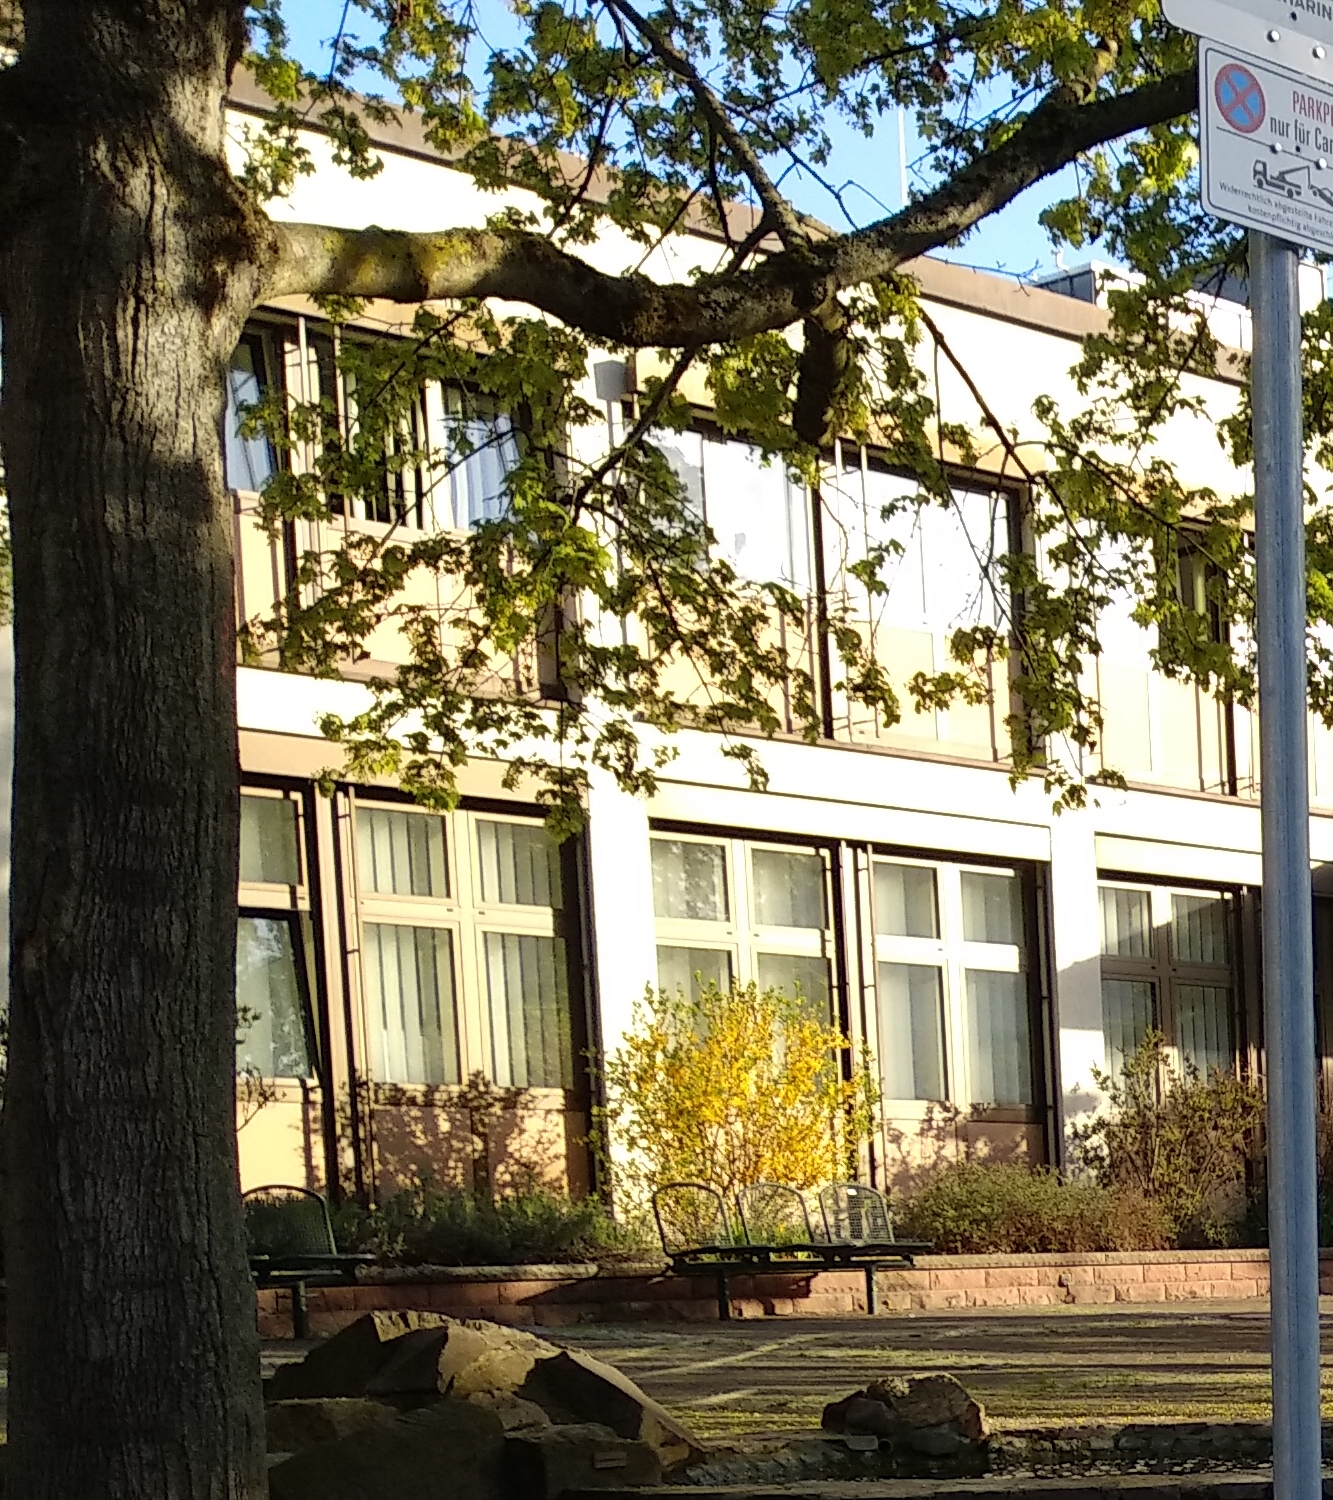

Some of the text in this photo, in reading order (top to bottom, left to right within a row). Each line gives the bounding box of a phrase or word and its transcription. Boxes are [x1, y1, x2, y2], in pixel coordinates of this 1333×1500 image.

[1270, 117, 1291, 139] nur
[1294, 118, 1311, 146] für
[1219, 182, 1273, 206] Widerrechtlich
[1274, 200, 1313, 221] abgestellte
[1247, 204, 1301, 232] kostenpflichtig
